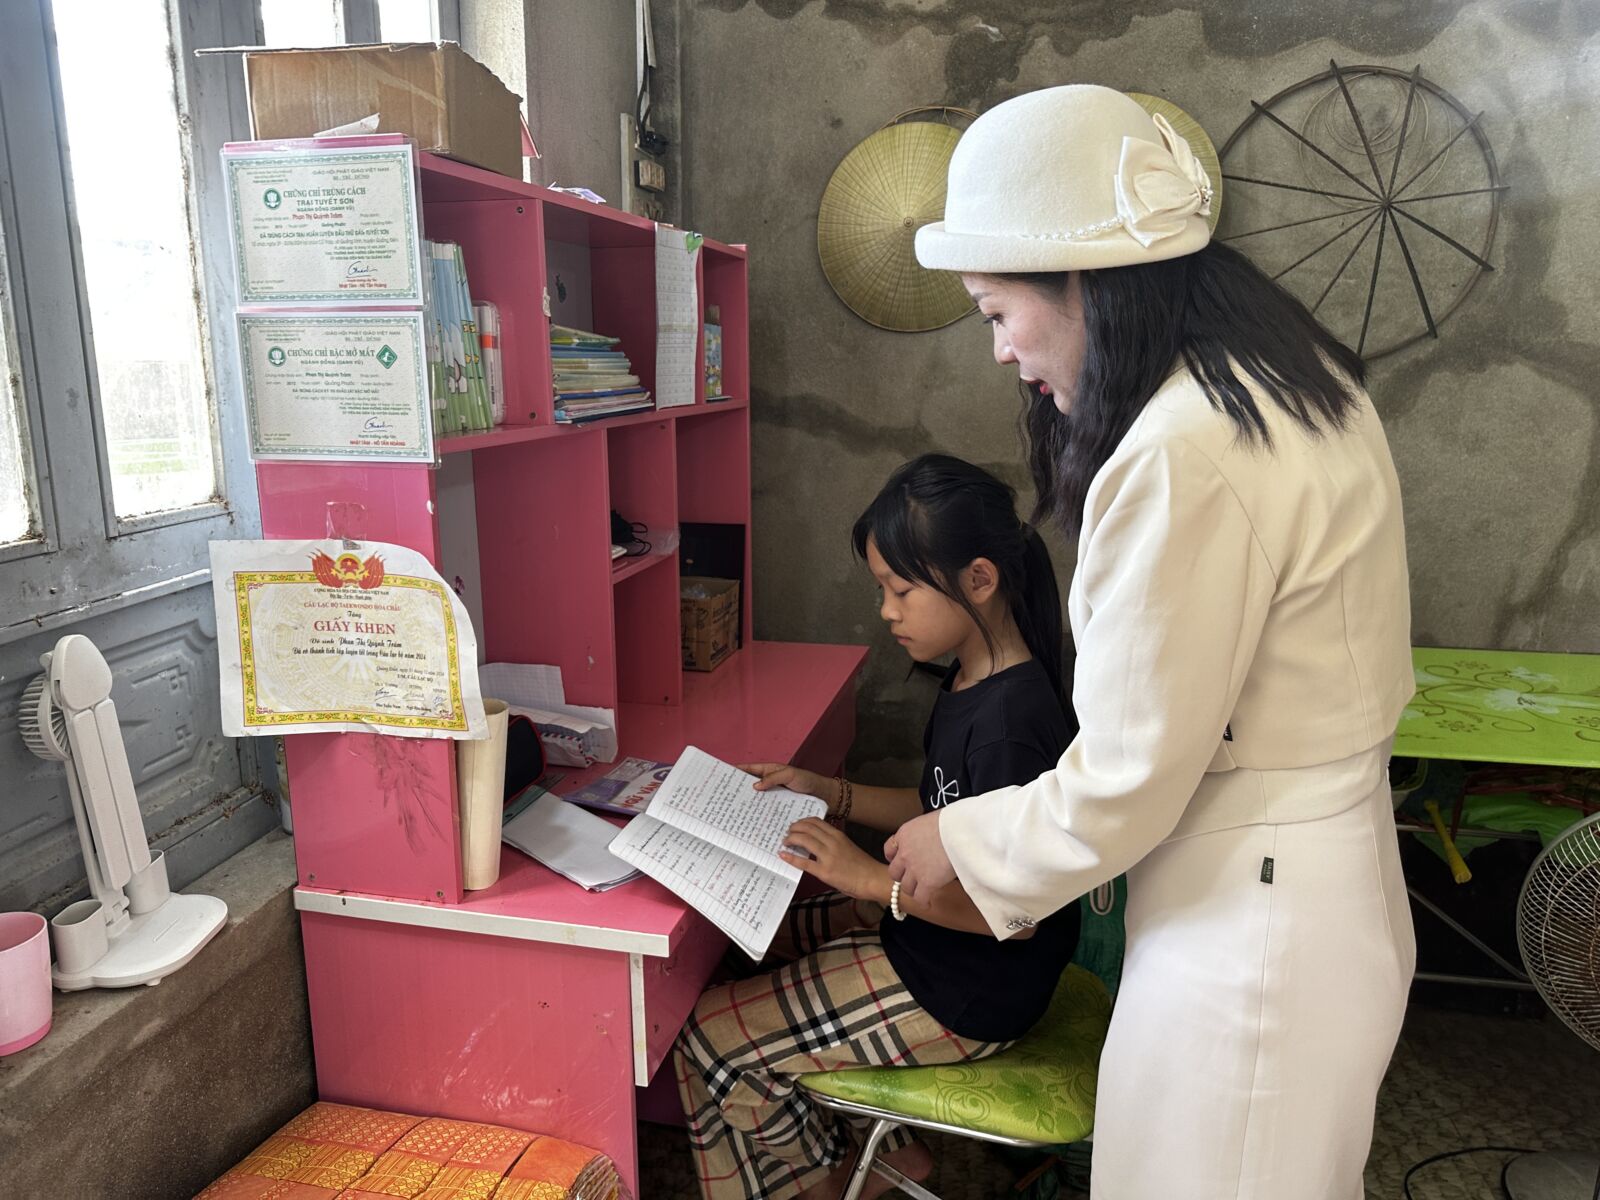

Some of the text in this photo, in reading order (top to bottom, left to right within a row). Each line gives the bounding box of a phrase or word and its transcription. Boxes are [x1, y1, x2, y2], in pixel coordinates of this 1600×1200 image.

[283, 188, 307, 198] CHỨNG
[308, 186, 321, 198] CHỈ
[346, 186, 366, 196] CÁCH
[314, 346, 328, 357] CHỈ
[329, 348, 344, 359] BẬC
[346, 346, 358, 357] MỞ
[313, 616, 396, 635] GIẤY KHEN
